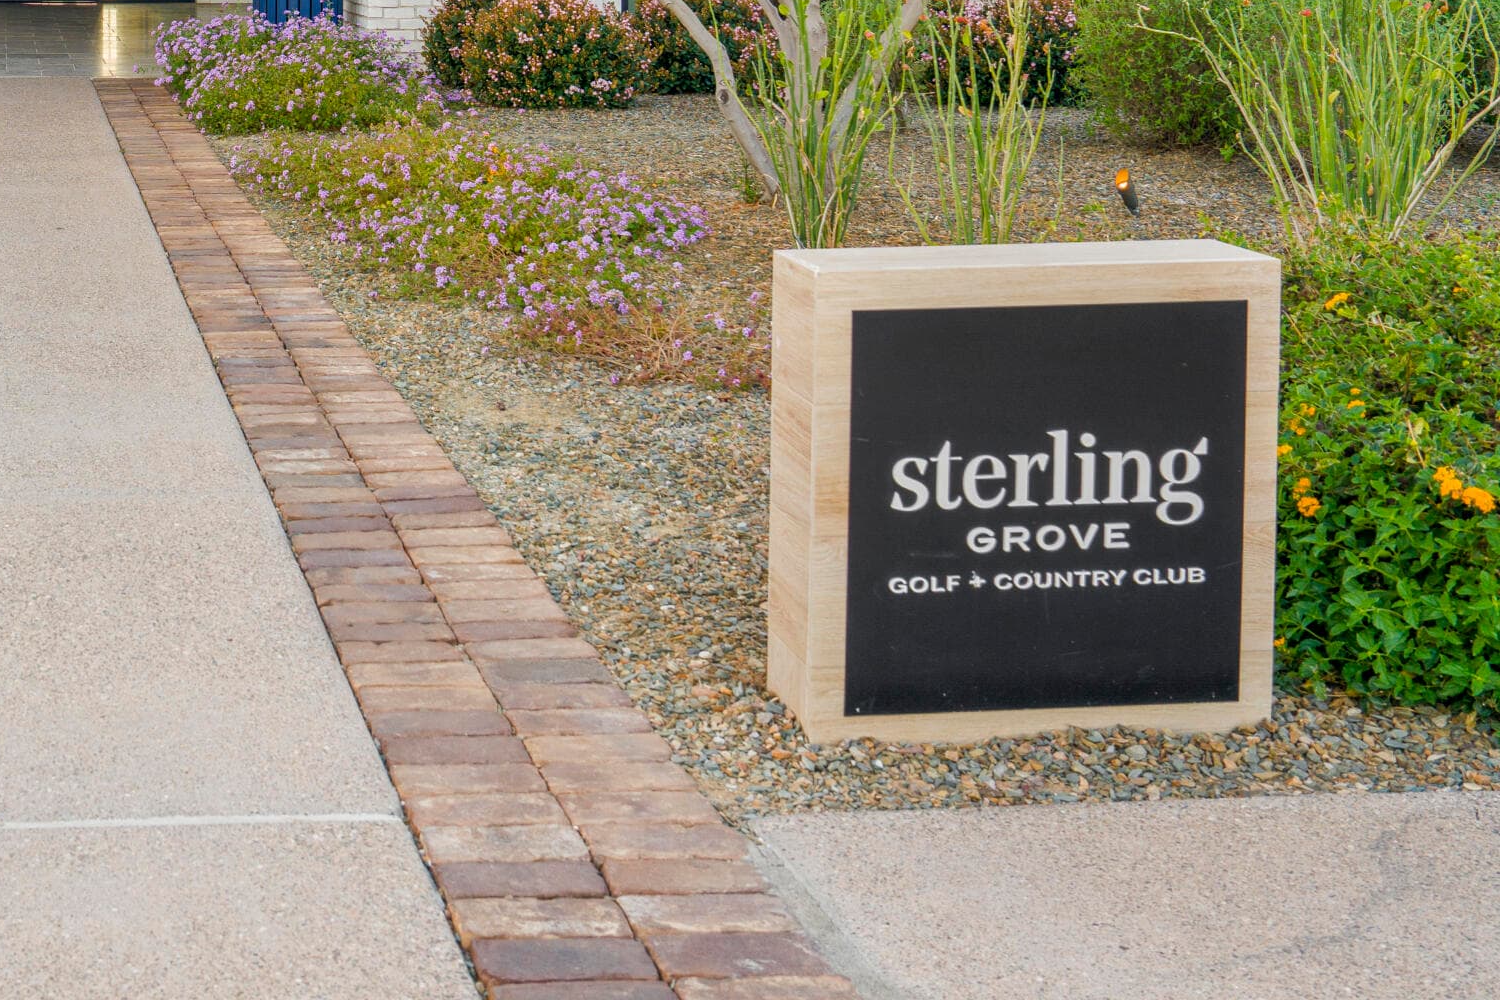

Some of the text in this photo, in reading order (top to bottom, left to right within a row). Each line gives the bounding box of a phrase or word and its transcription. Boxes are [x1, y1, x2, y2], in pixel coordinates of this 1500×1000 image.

[889, 428, 1209, 526] sterling
[966, 522, 1131, 554] GROVE
[887, 574, 962, 595] GOLF
[993, 568, 1128, 591] COUNTRY
[1132, 566, 1206, 586] CLUB
